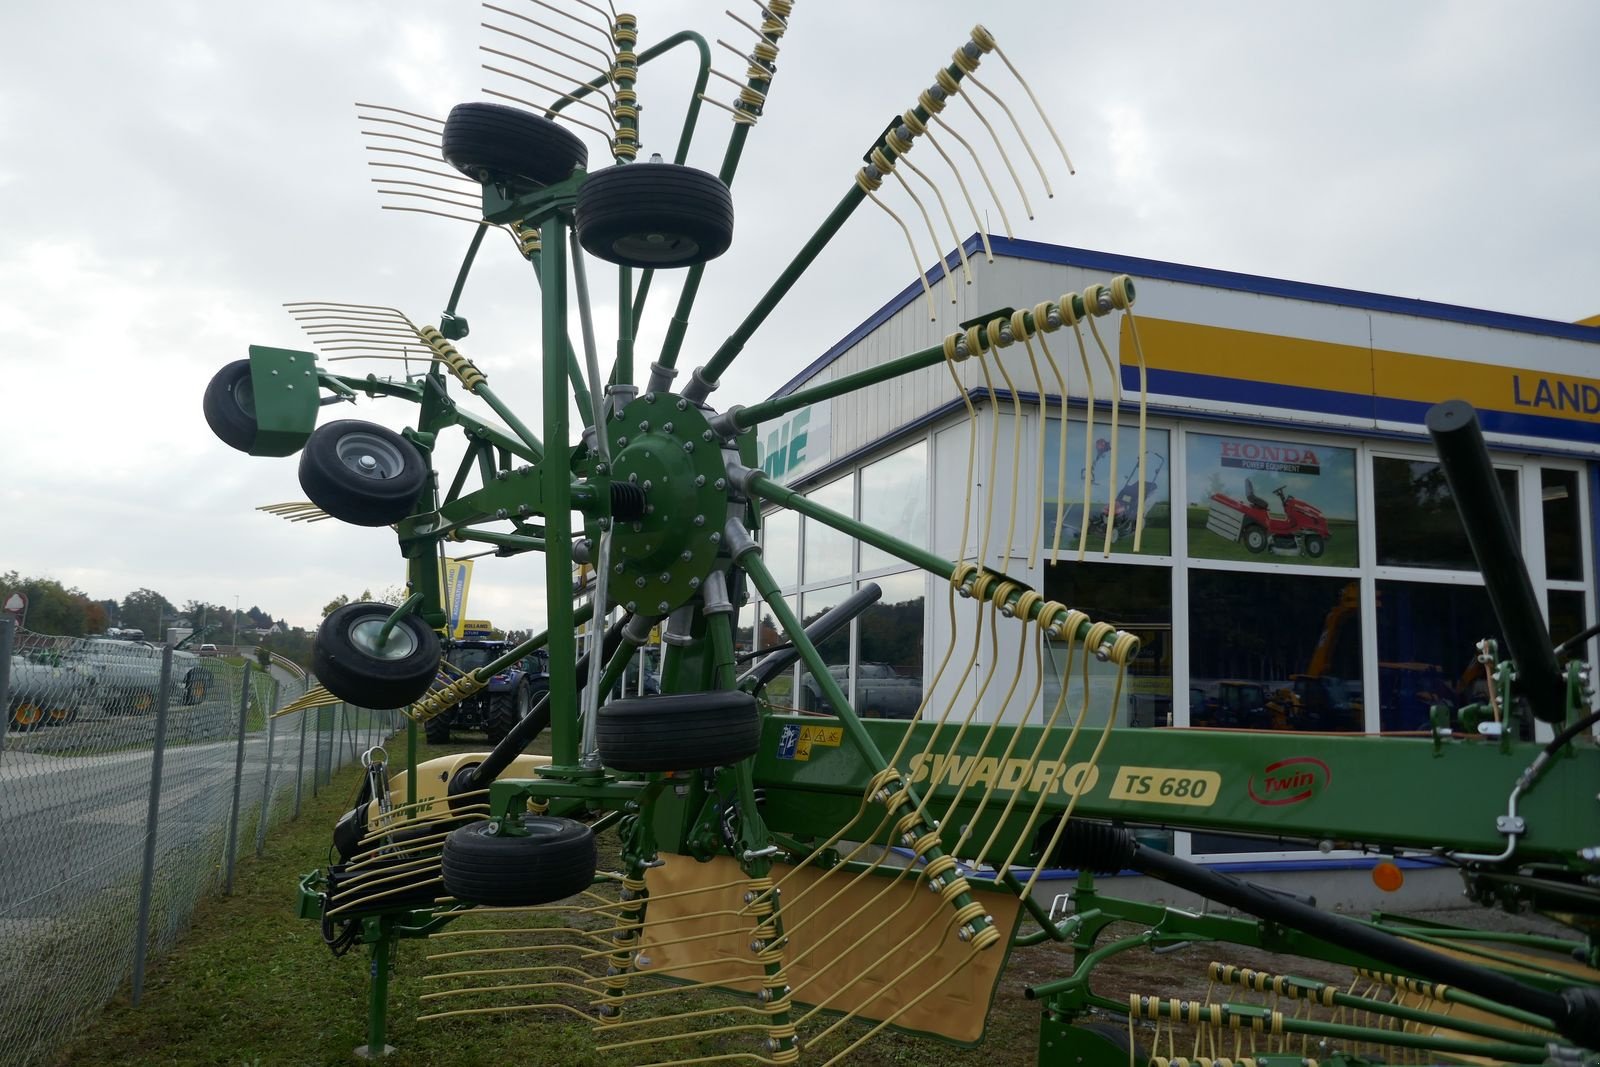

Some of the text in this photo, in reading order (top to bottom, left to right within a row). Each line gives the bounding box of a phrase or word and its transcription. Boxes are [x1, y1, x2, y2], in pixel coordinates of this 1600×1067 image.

[1221, 441, 1320, 465] HONDA
[1242, 460, 1300, 473] POWER EQUIPMENT
[907, 753, 1208, 799] SWADRO TS 680
[1264, 771, 1314, 793] Twin
